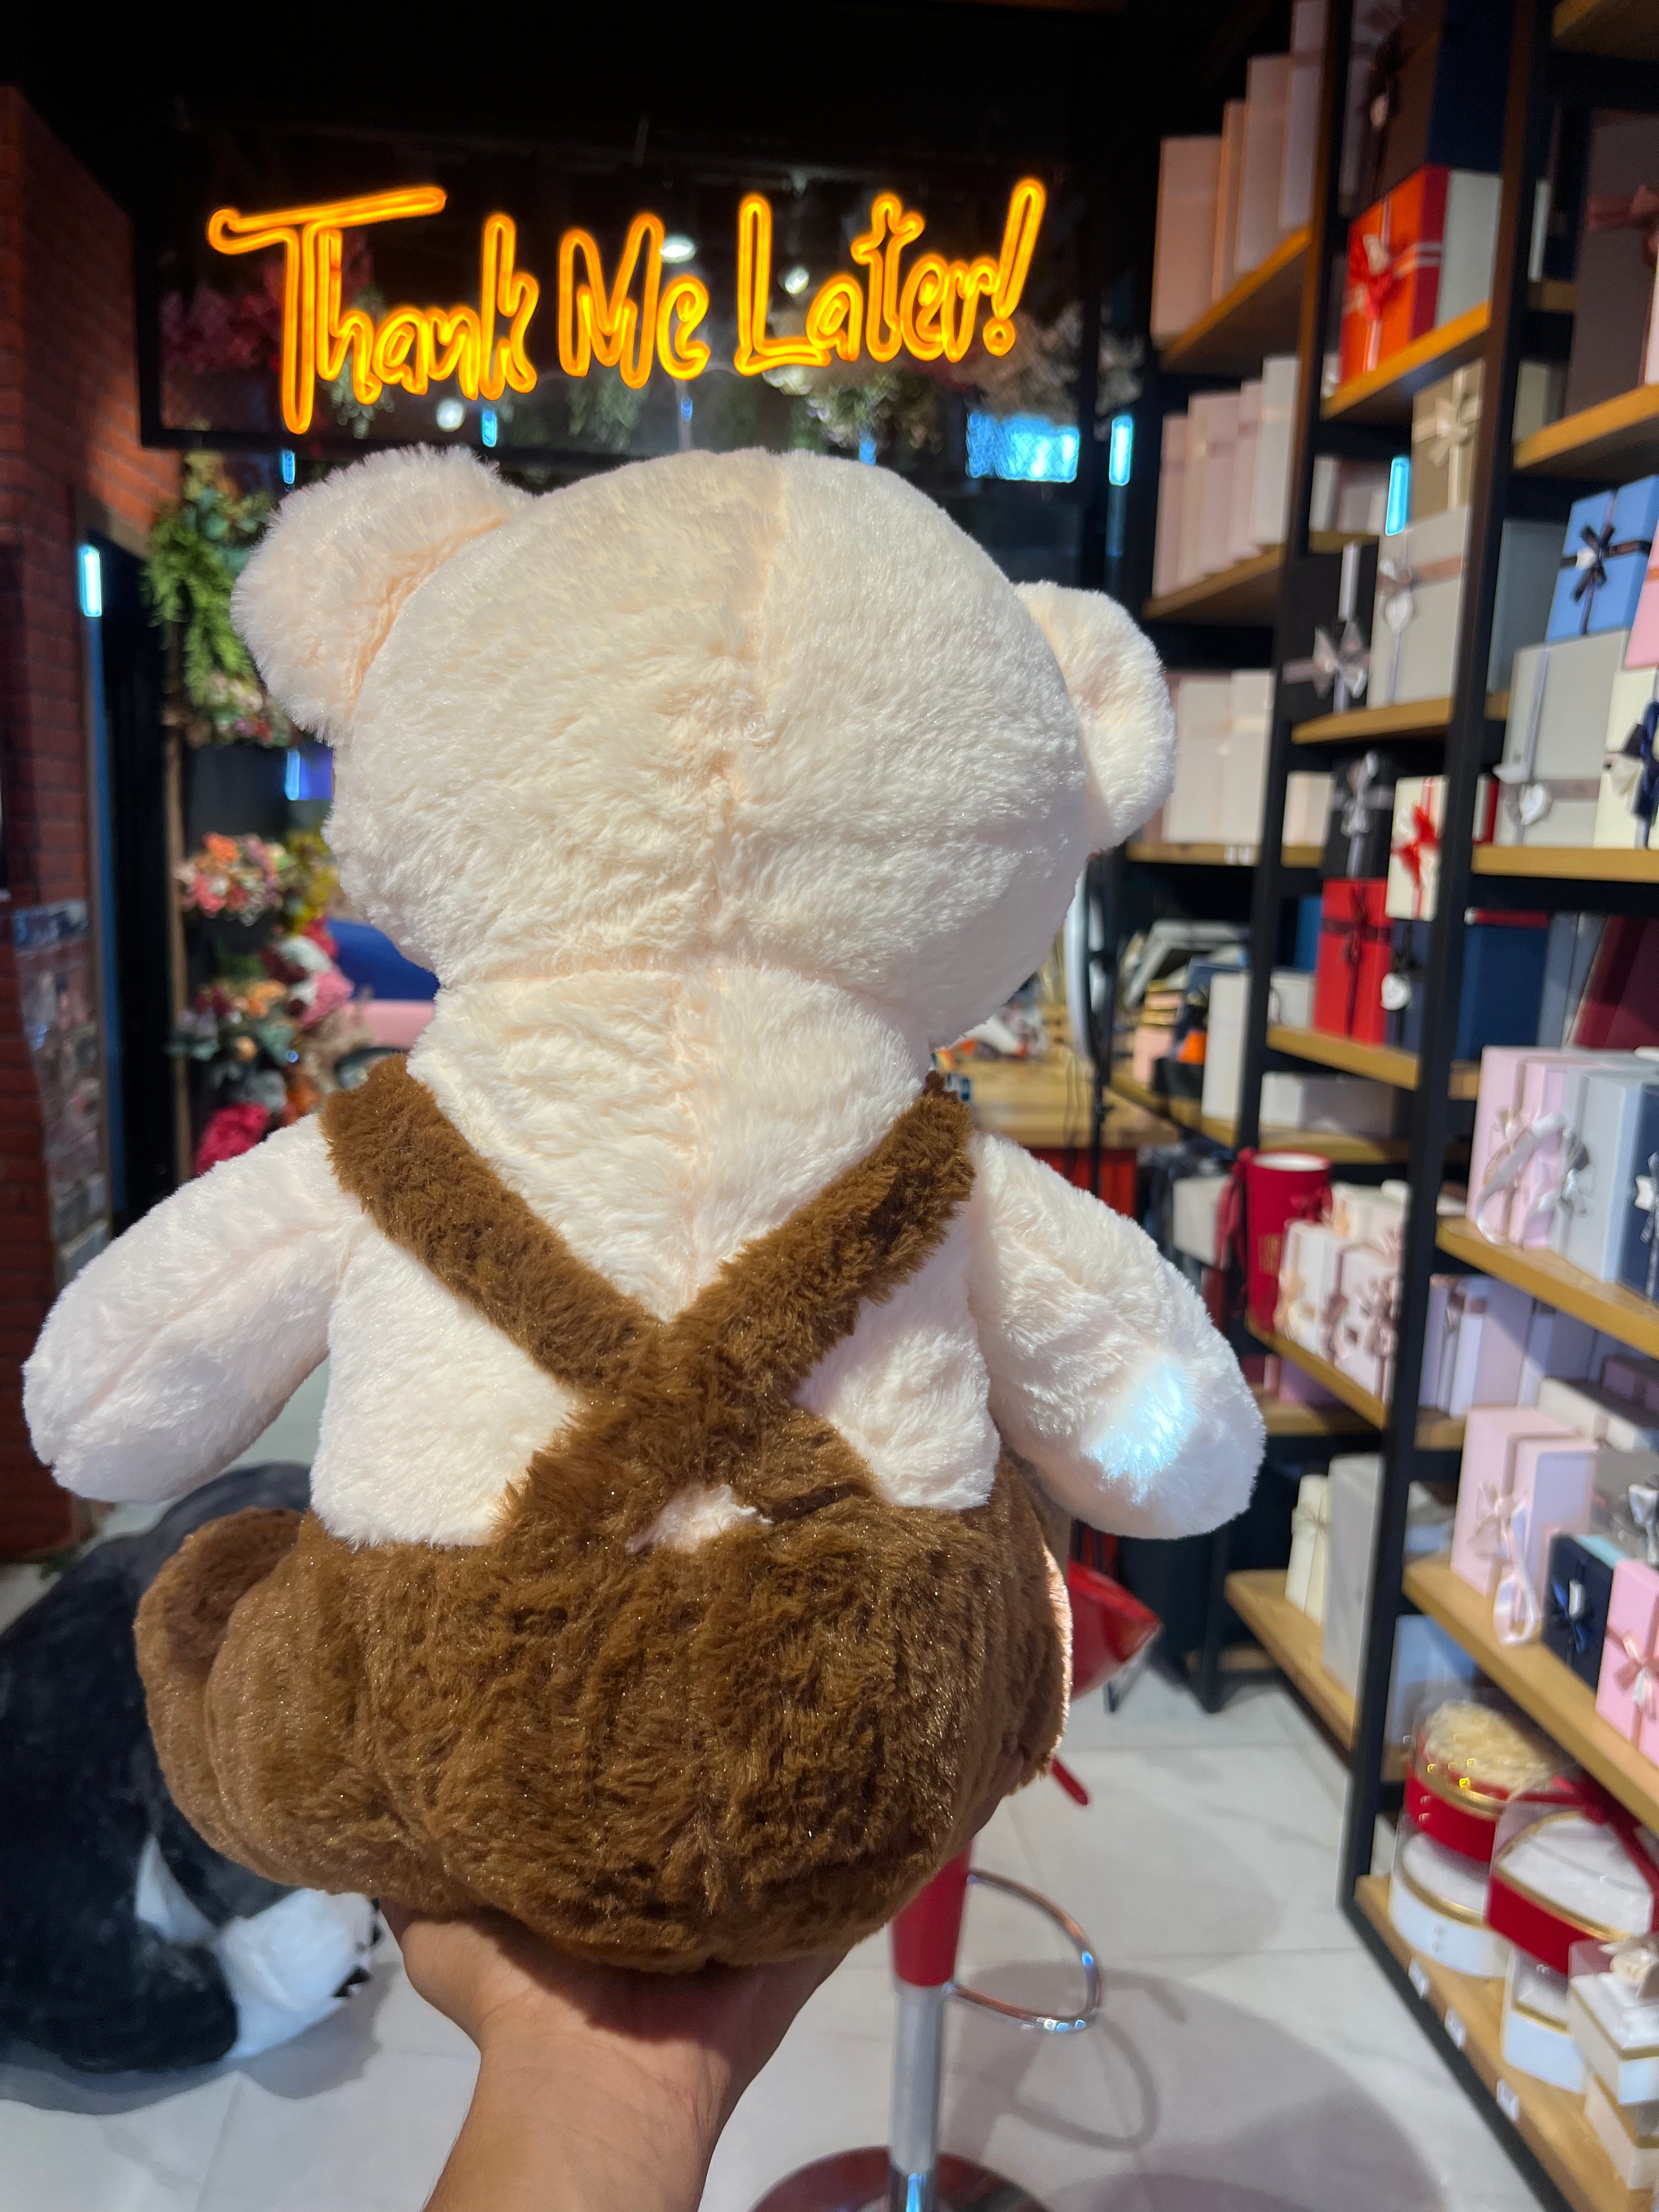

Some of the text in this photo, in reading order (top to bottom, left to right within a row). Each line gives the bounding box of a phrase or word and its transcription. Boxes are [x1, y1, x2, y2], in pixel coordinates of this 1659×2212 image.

[207, 177, 1046, 435] Thank Me Later!
